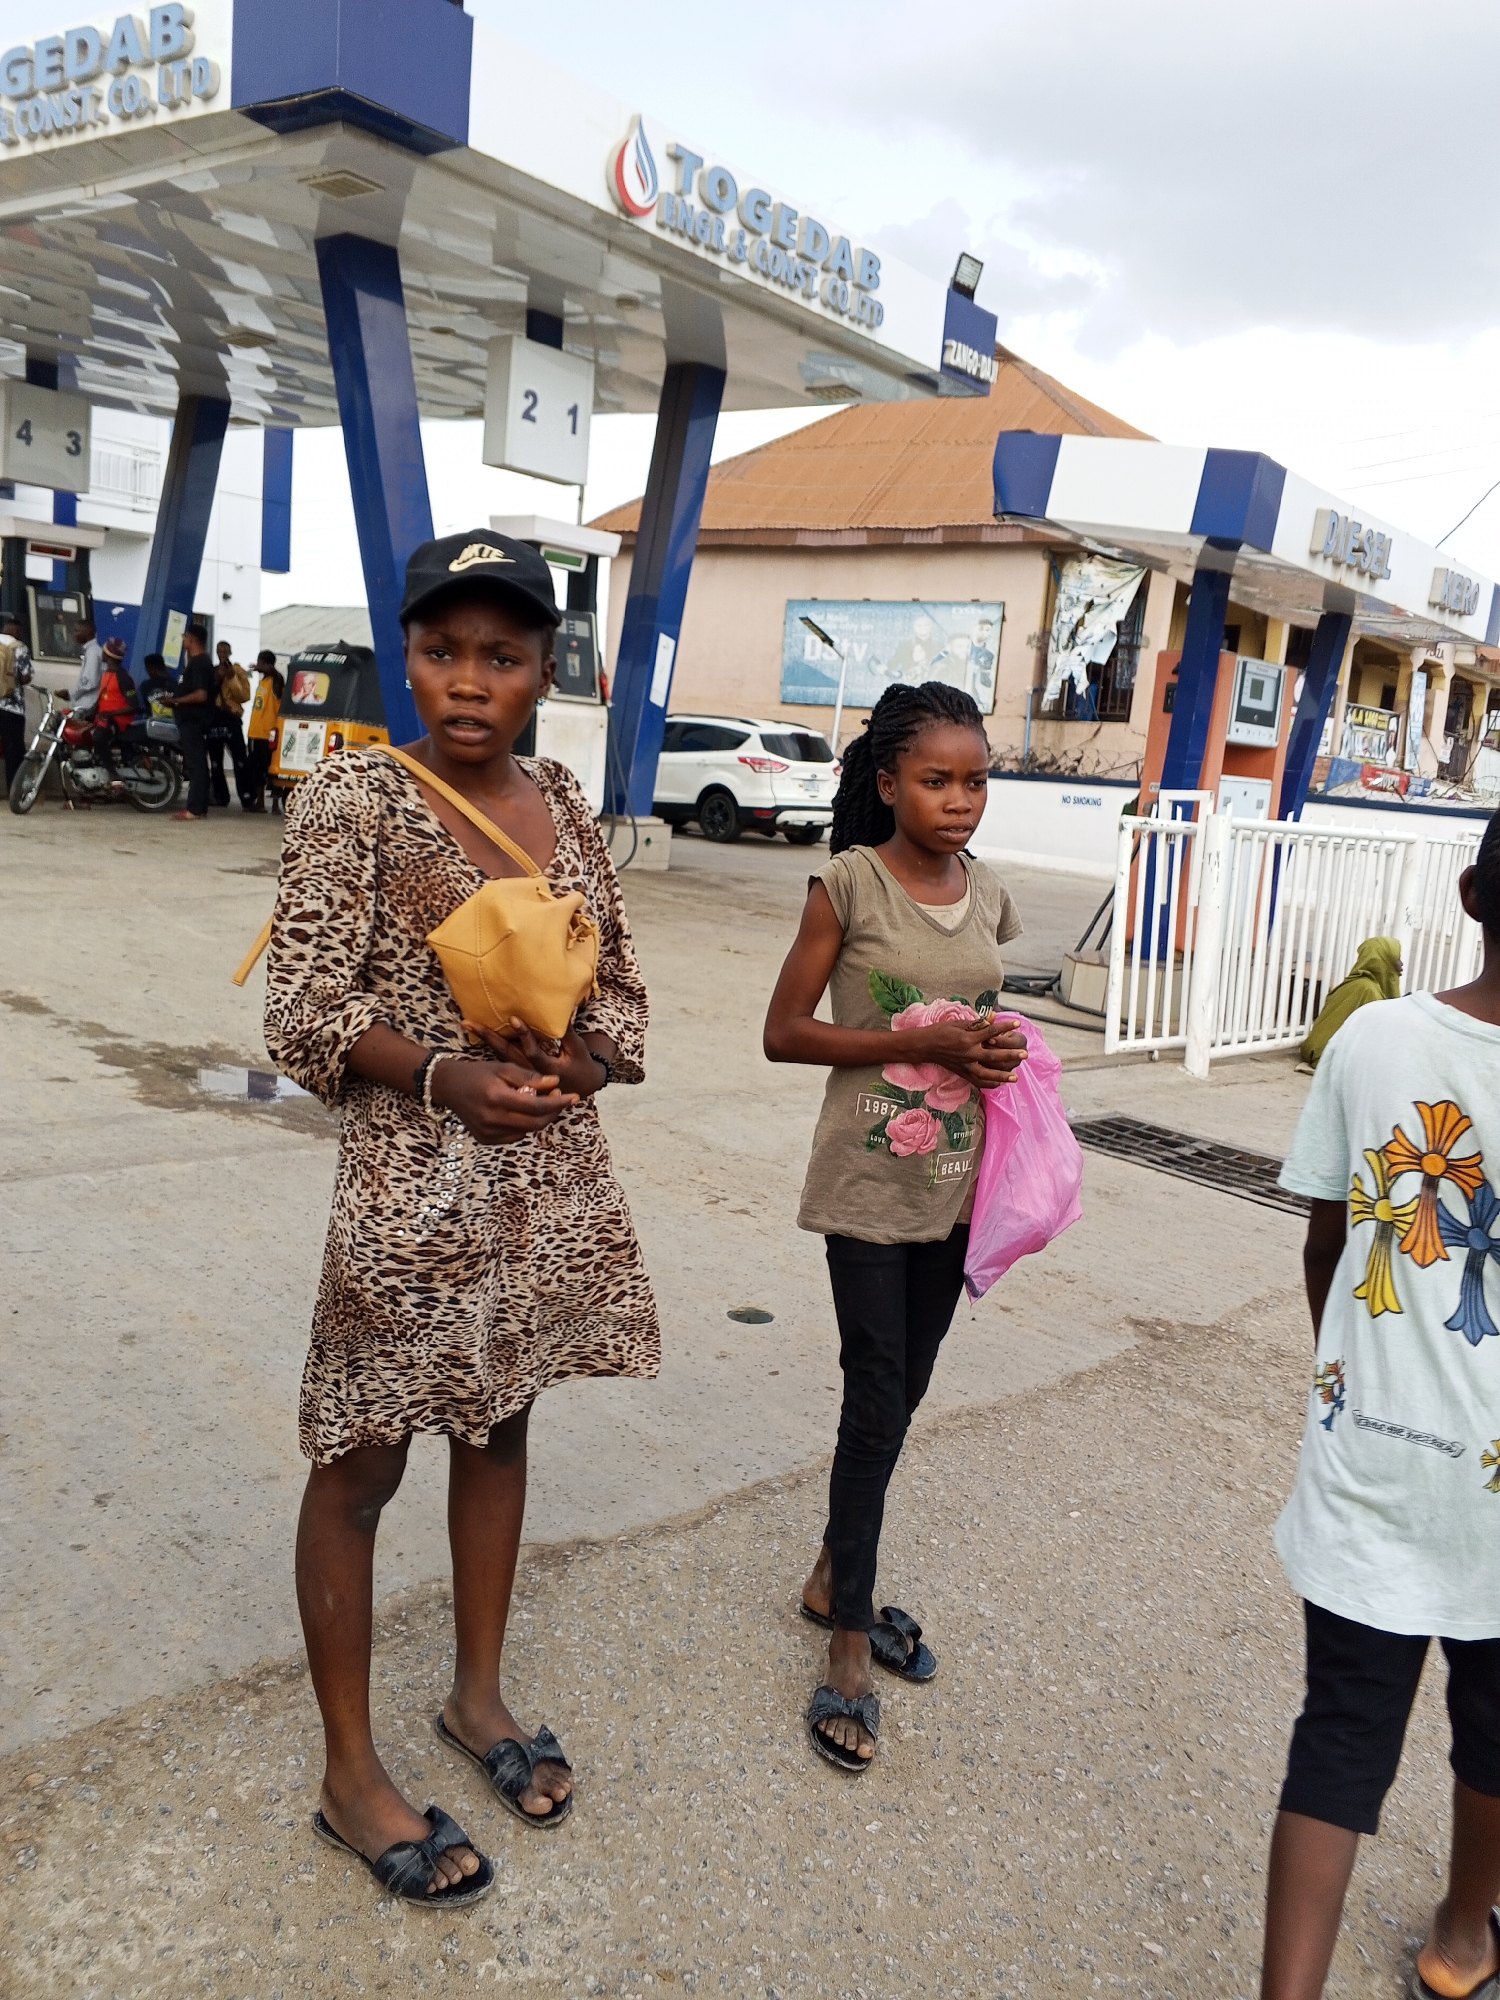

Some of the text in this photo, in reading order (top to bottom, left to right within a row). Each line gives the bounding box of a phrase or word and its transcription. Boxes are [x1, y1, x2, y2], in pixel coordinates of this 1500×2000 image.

[15, 85, 107, 138] CONST.
[108, 74, 155, 119] CO.
[158, 56, 217, 107] LTD
[668, 143, 881, 290] TOGEDAB
[658, 192, 728, 254] ENGR.
[731, 228, 748, 262] &
[750, 239, 819, 298] CONST.
[852, 291, 884, 328] LTD
[522, 389, 578, 435] 2 1
[16, 418, 82, 457] 4 3
[1317, 508, 1392, 580] DIESEL
[1433, 567, 1480, 616] KERO
[803, 634, 869, 663] DStv
[1062, 795, 1101, 806] NO SMOKING
[864, 1099, 898, 1118] 1987
[870, 1134, 886, 1144] LOVE
